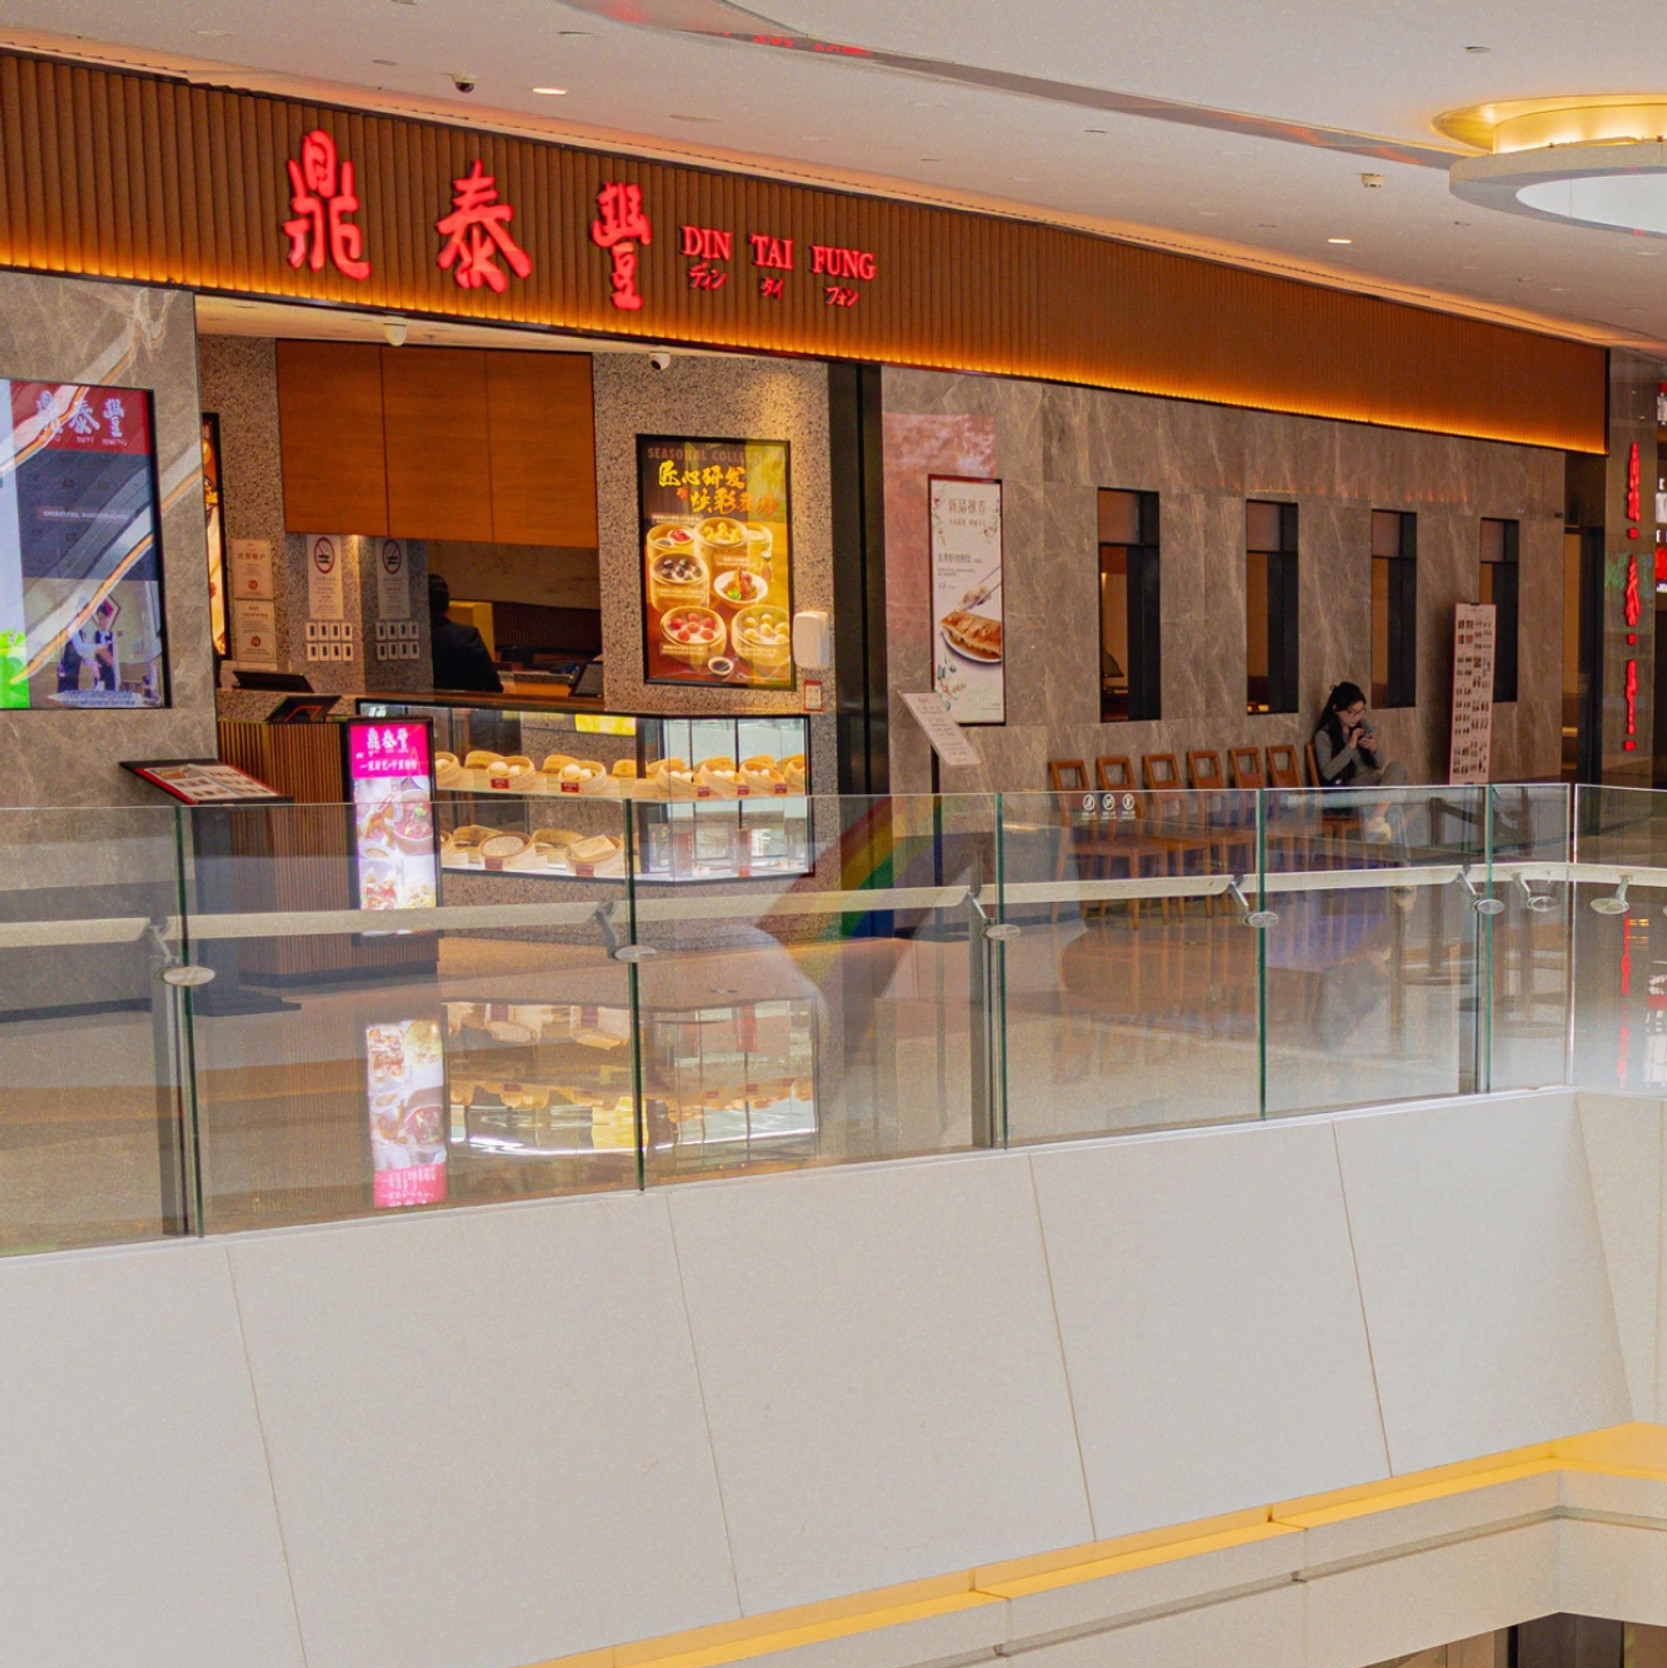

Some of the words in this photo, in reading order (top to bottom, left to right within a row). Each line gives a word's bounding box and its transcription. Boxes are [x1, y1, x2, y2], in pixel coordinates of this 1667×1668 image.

[282, 128, 654, 311] 鼎泰豐
[682, 226, 731, 260] DIN
[752, 233, 794, 270] TAI
[812, 245, 876, 281] FUNG
